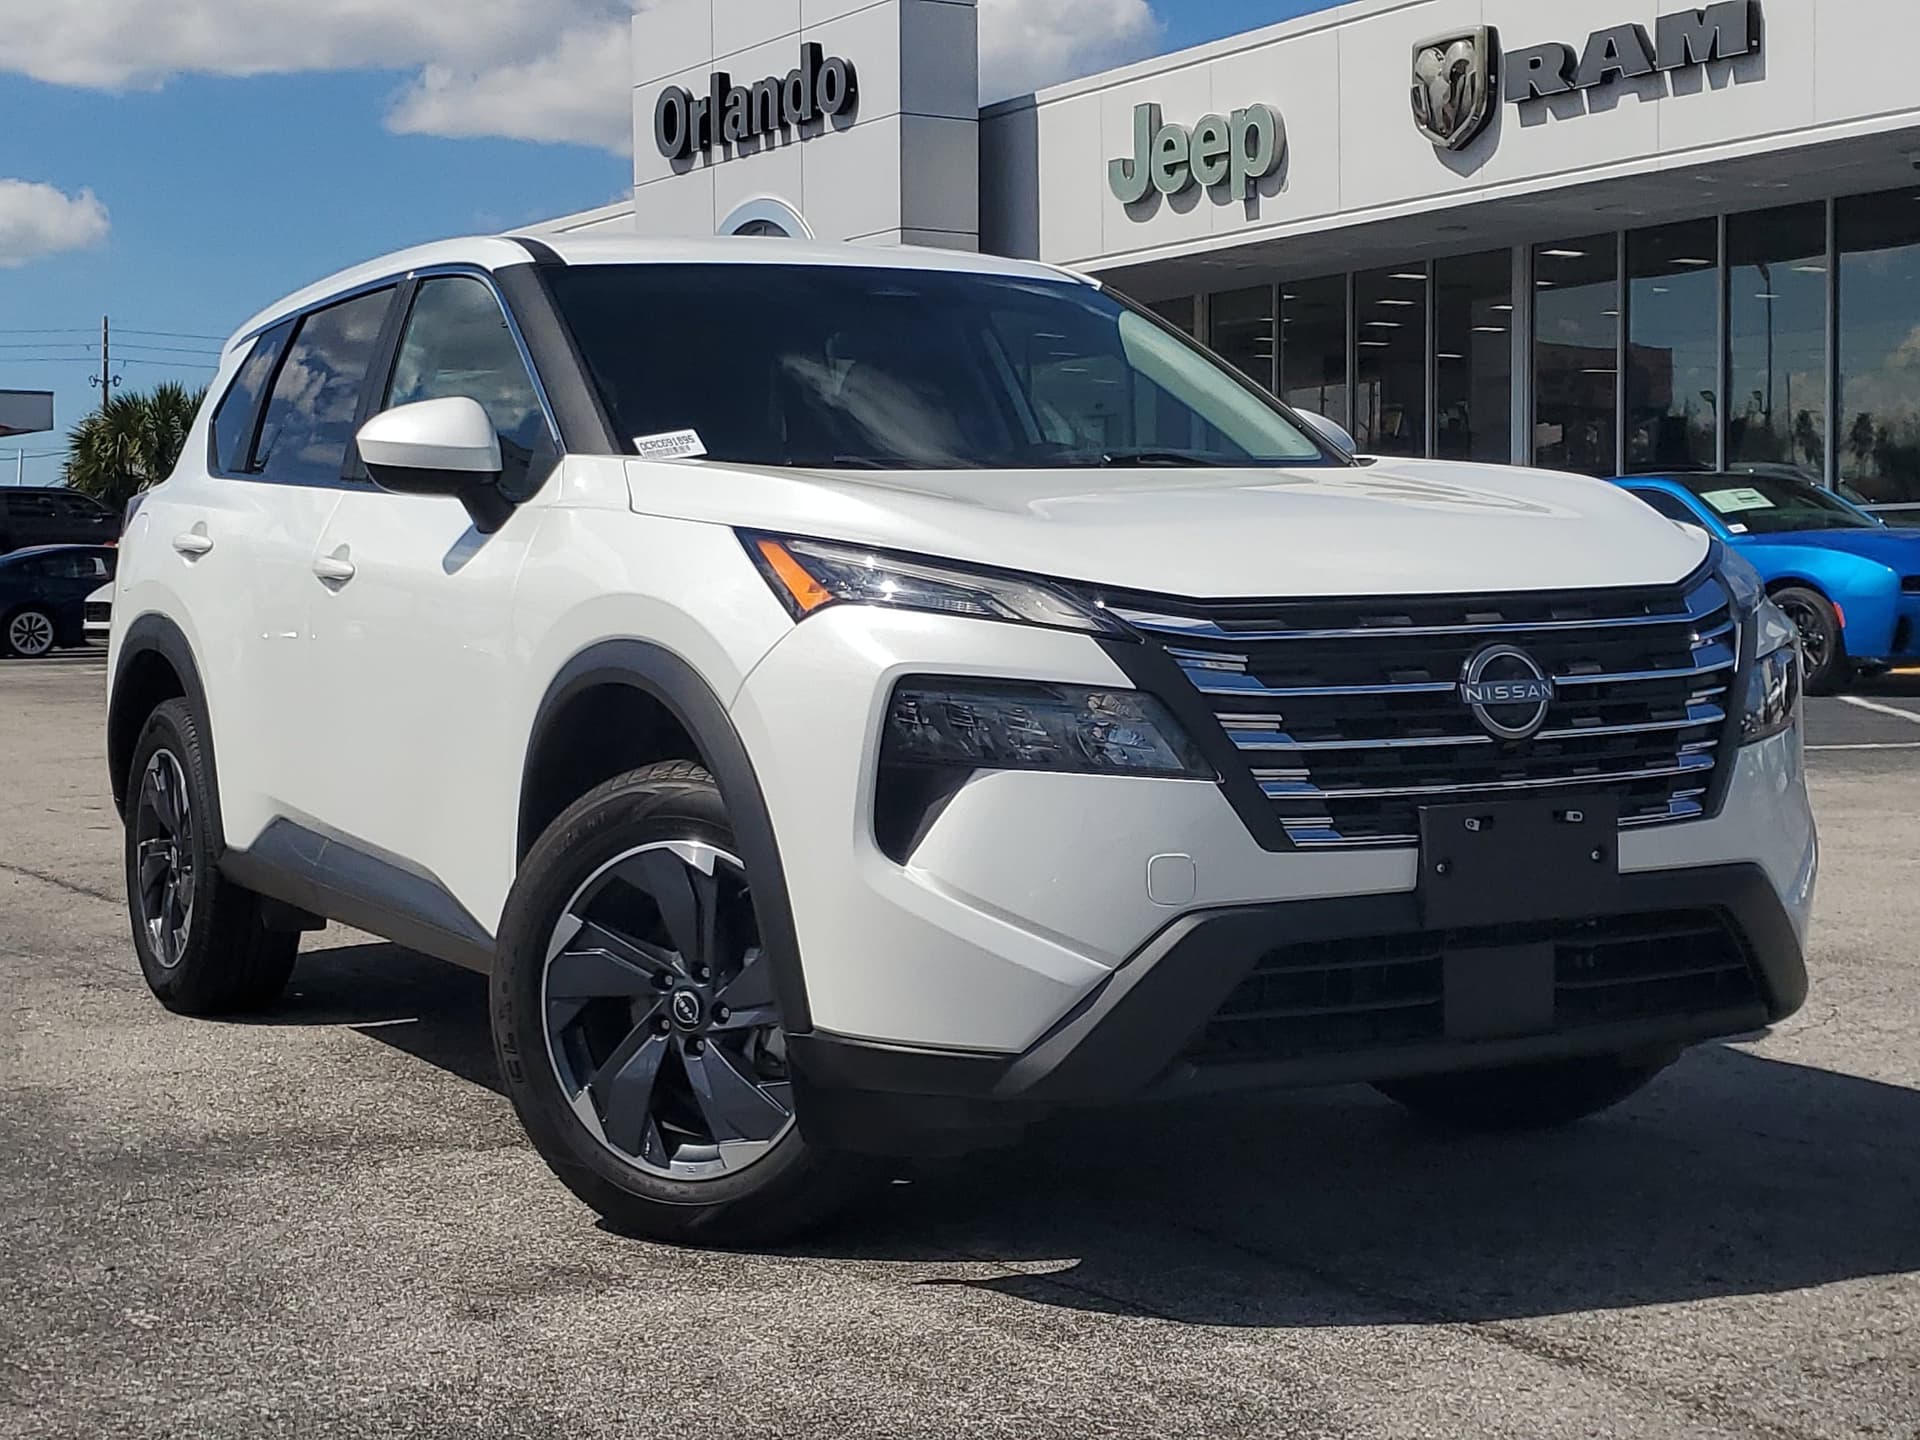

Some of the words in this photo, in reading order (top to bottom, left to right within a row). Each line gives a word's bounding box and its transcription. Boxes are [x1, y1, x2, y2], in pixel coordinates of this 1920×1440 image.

[654, 42, 859, 159] Orlando
[1503, 0, 1761, 103] RAM
[1107, 102, 1286, 203] Jeep
[1465, 682, 1553, 701] NISSAN
